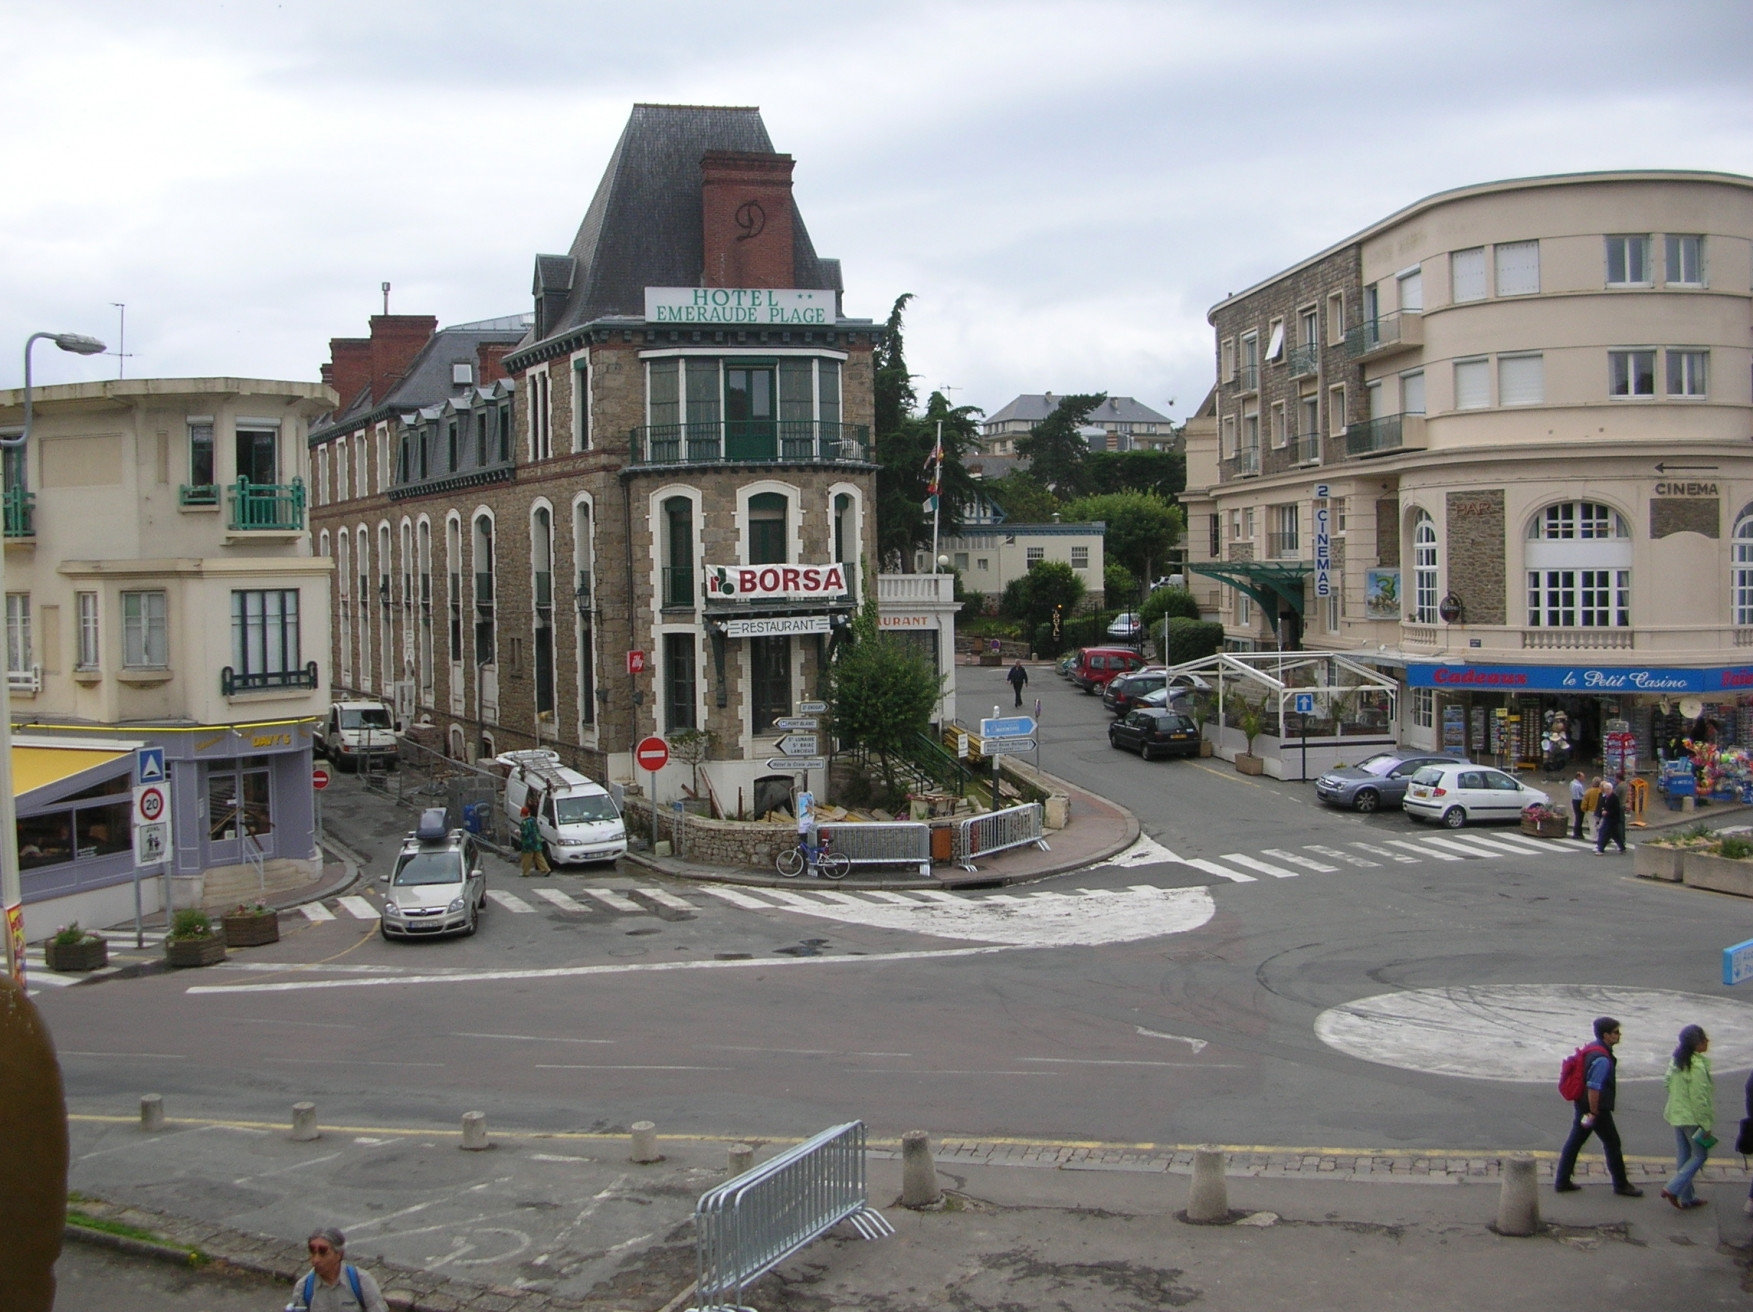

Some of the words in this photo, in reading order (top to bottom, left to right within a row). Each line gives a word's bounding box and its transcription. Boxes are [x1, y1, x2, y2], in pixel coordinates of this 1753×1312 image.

[693, 289, 779, 306] HOTEL
[657, 305, 757, 322] EMERAUDE
[769, 308, 825, 323] PLAGE
[1317, 485, 1329, 497] 2
[1655, 483, 1718, 496] CINEMA
[1456, 502, 1492, 516] BAR
[1316, 509, 1330, 596] CINEMAS
[739, 568, 844, 593] BORSA
[741, 619, 816, 634] RESTAURANT
[1433, 668, 1527, 685] Cadeaux
[1563, 671, 1576, 686] le
[1584, 670, 1626, 687] Petit
[1629, 671, 1688, 688] Casino
[146, 798, 159, 811] 20
